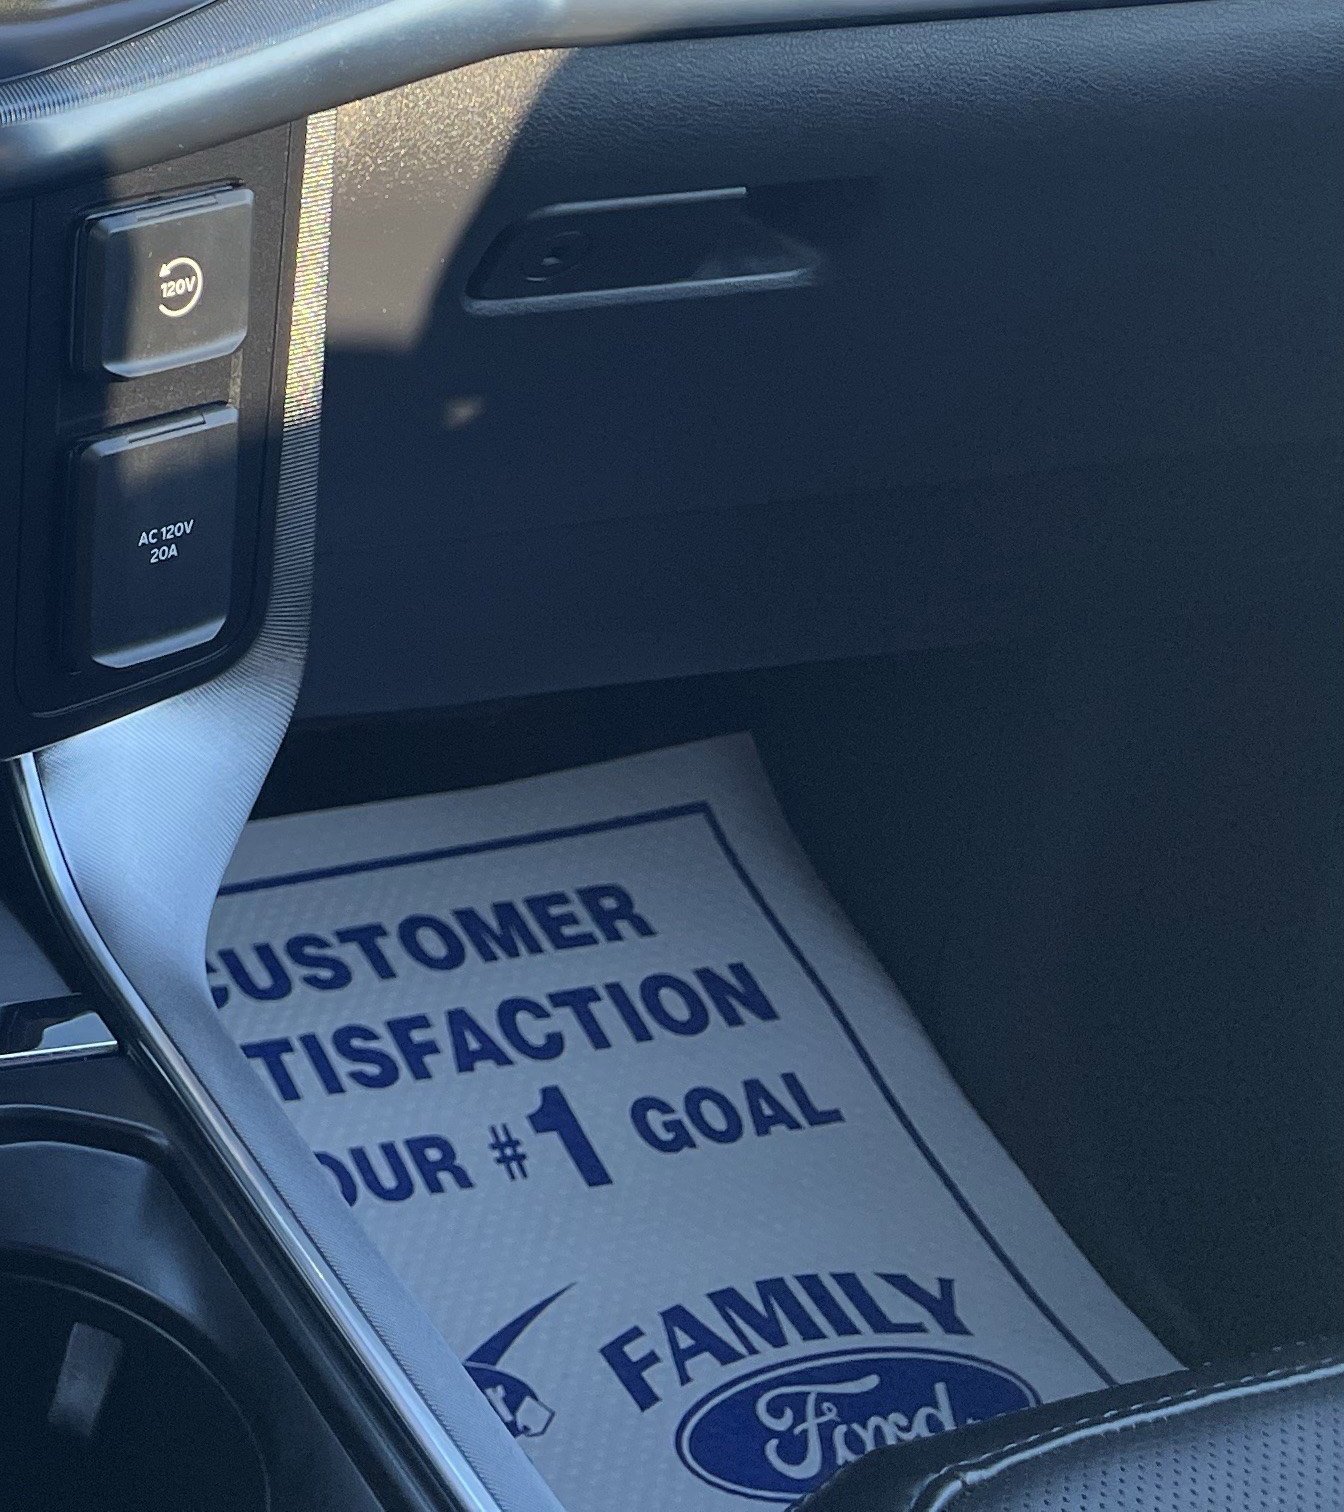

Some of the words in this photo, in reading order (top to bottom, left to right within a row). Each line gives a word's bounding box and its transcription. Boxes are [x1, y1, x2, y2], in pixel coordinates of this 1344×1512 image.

[161, 276, 196, 299] 120V
[138, 528, 159, 548] AC
[161, 519, 194, 540] 120V
[150, 546, 178, 564] 20A
[240, 961, 780, 1102] TISFACTION
[629, 1071, 846, 1154] GOAL
[598, 1271, 977, 1413] FAMILY
[755, 1374, 958, 1480] Ford
